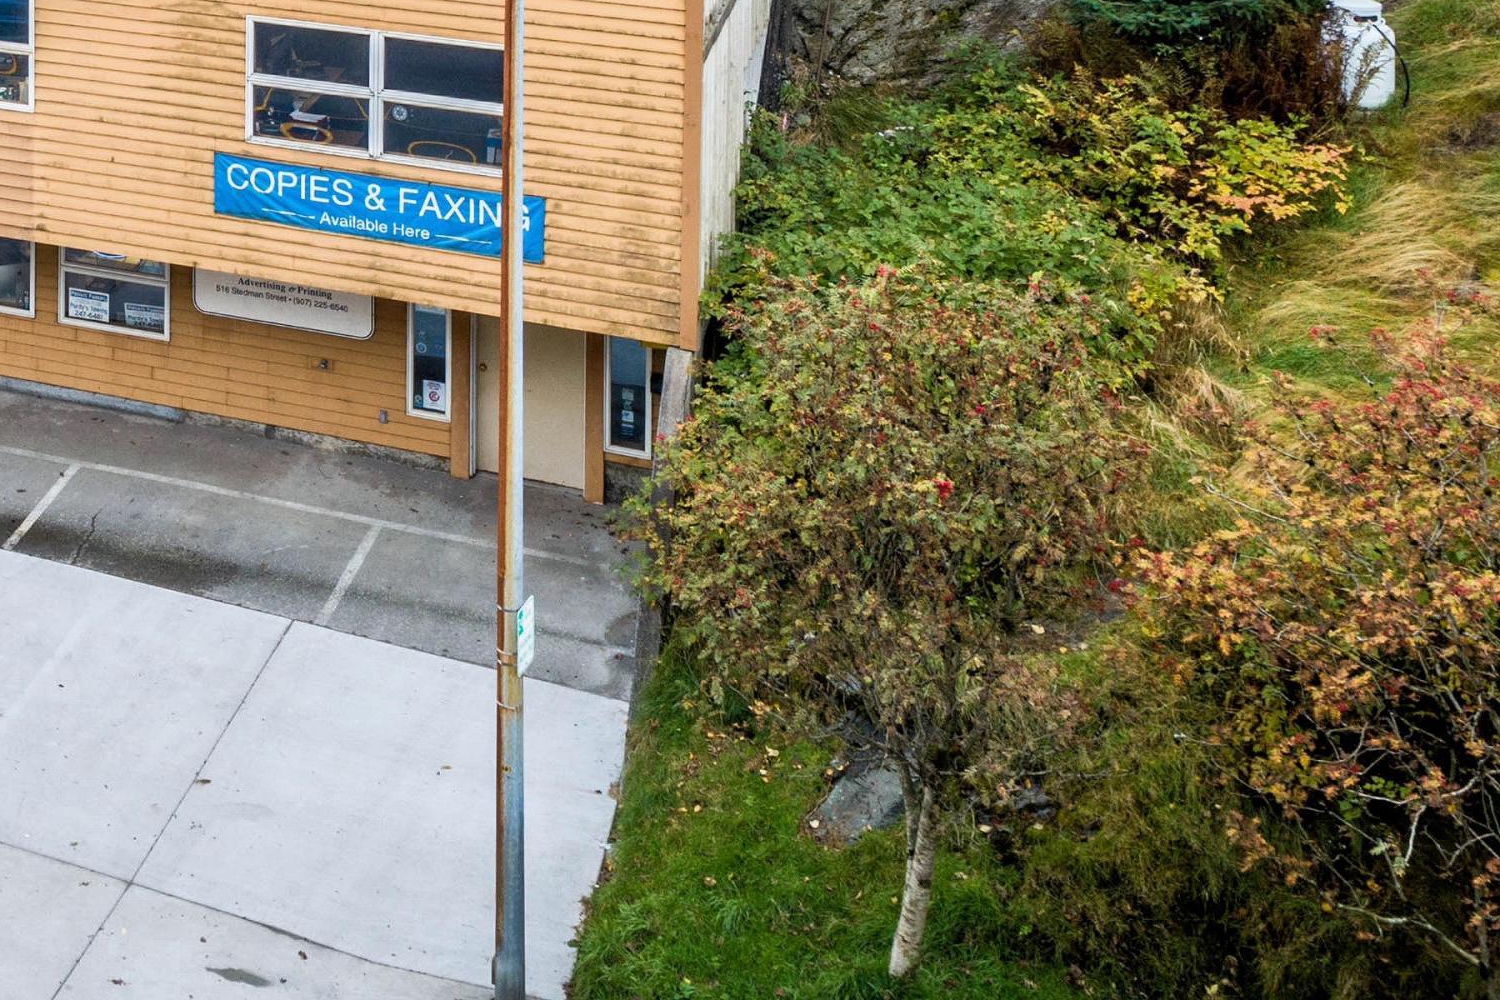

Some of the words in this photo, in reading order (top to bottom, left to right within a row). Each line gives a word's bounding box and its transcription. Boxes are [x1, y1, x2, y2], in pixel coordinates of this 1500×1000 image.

[226, 162, 353, 207] COPIES
[364, 183, 387, 212] &
[319, 211, 388, 234] Available
[393, 222, 431, 241] Here
[215, 284, 230, 294] 516
[231, 287, 264, 299] Stedman
[265, 291, 287, 303] Street
[238, 278, 286, 293] Advertising
[297, 286, 332, 300] Printing
